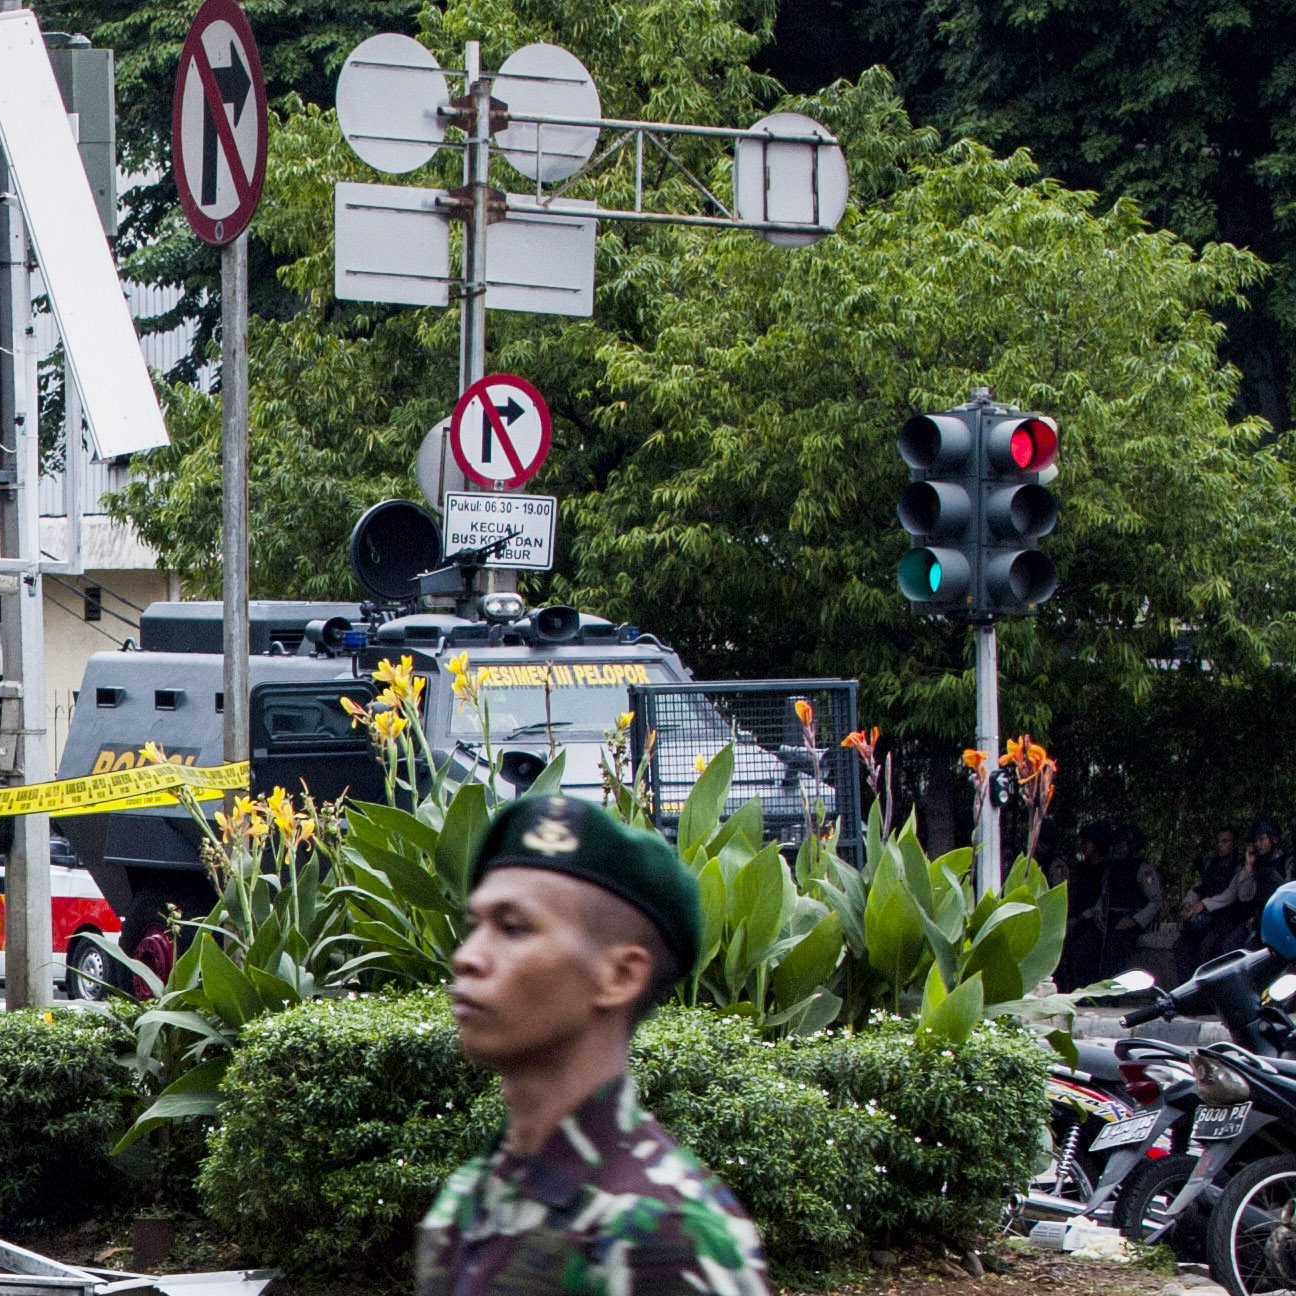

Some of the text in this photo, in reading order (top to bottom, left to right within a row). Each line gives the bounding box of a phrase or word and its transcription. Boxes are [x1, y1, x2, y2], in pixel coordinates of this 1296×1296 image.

[450, 499, 481, 512] Pukul:
[485, 501, 511, 513] 06.30
[523, 503, 550, 516] 19.00
[470, 521, 524, 534] KECUALI
[452, 533, 476, 545] BUS
[516, 537, 543, 548] DAN
[573, 664, 650, 685] PELOPOR
